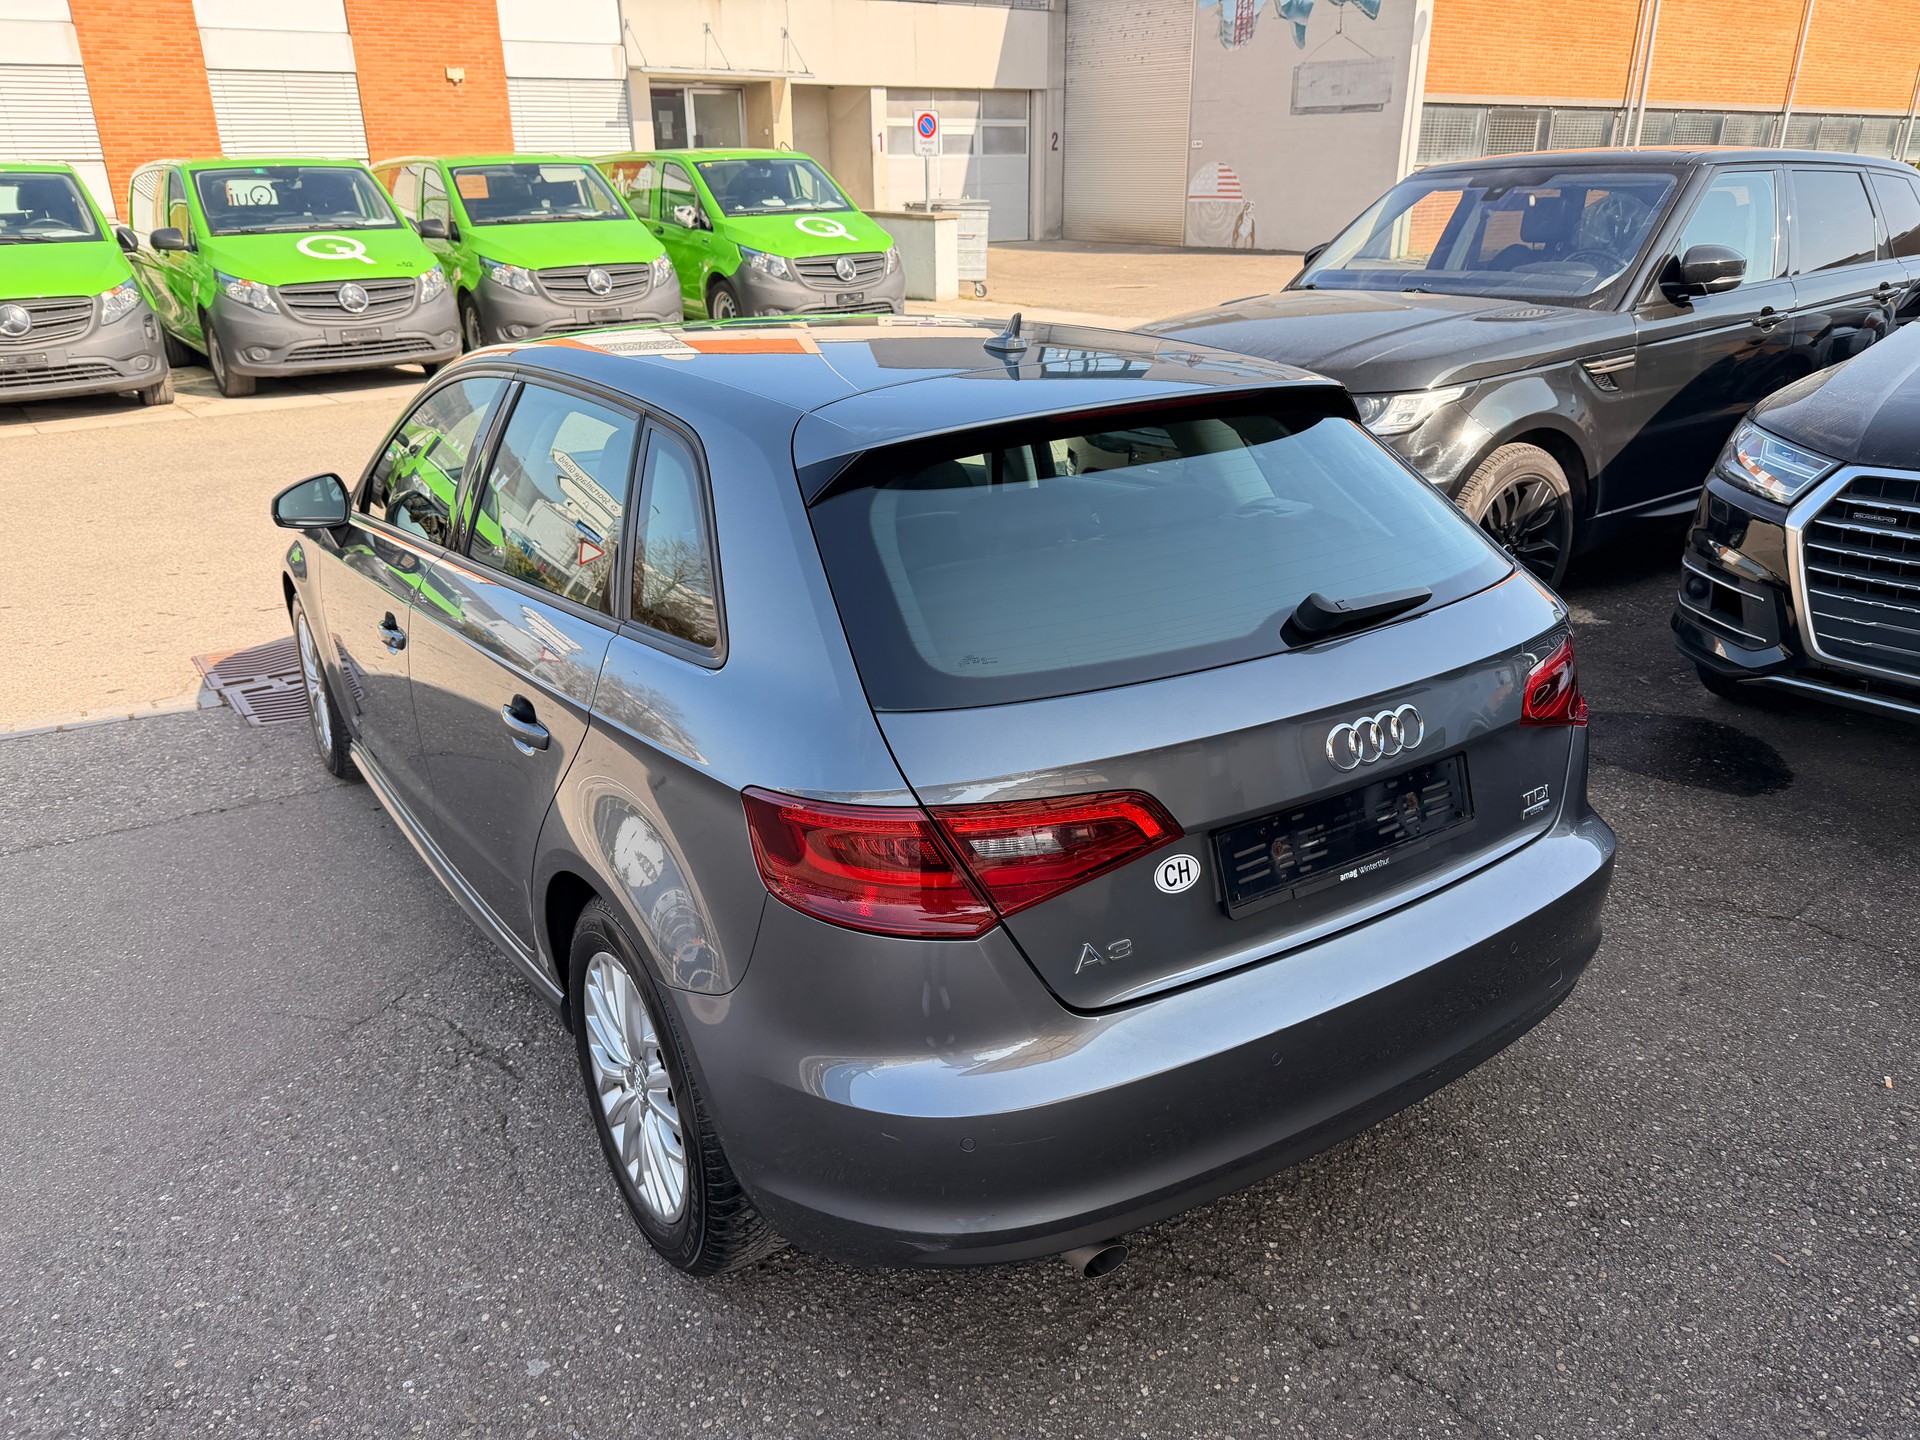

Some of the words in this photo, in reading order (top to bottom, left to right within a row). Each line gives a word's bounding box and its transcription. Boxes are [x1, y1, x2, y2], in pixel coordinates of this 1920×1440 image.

[877, 132, 883, 153] 1
[1051, 132, 1059, 151] 2
[1522, 783, 1549, 806] TDI
[1164, 859, 1191, 887] CH
[1339, 868, 1358, 882] amag
[1358, 857, 1390, 874] Winterthur
[1075, 938, 1133, 974] A3
